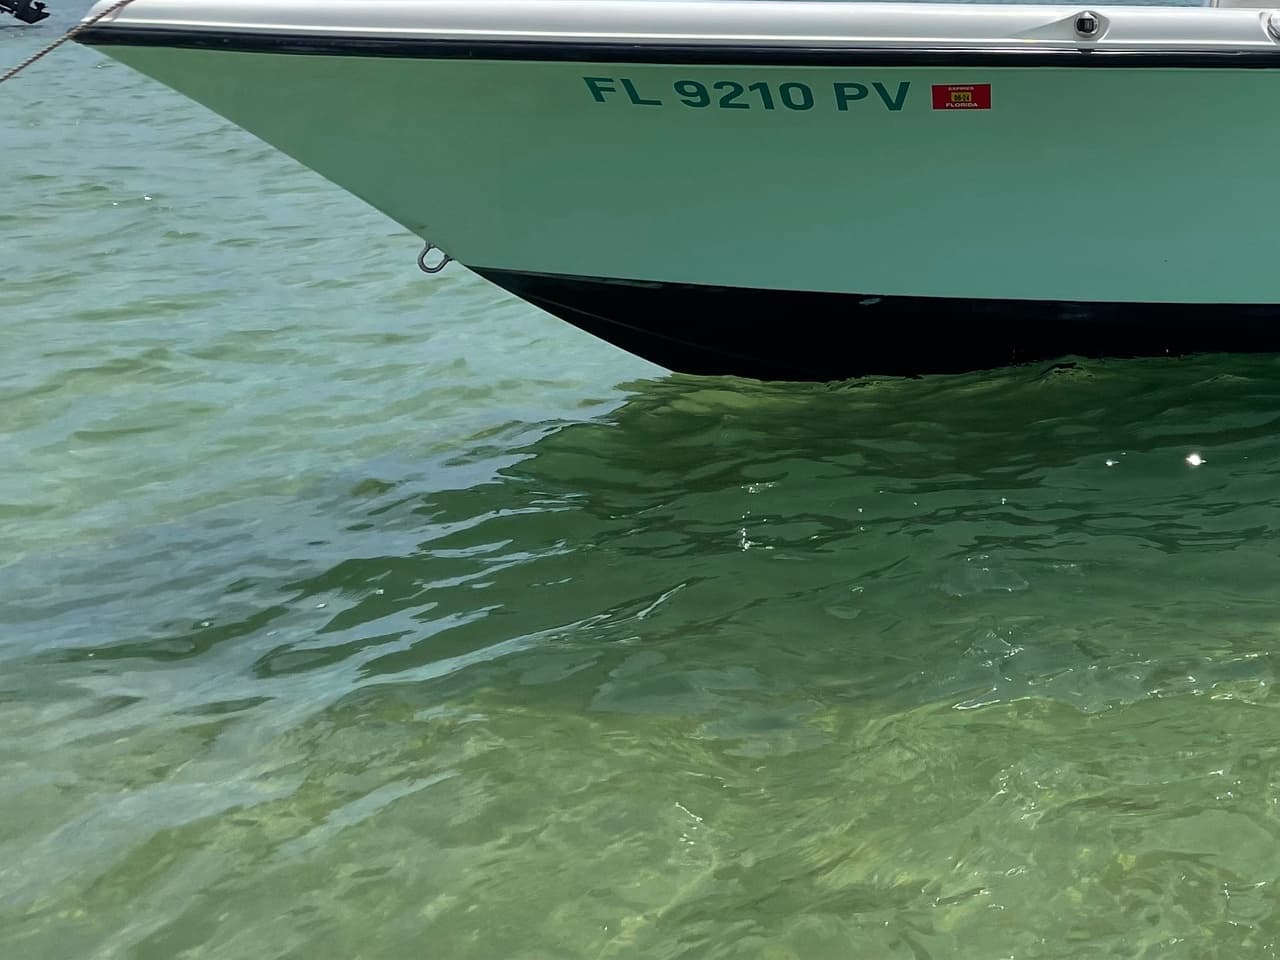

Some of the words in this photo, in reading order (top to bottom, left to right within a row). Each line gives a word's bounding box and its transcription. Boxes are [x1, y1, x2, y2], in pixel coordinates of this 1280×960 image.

[583, 76, 663, 106] FL
[673, 79, 815, 111] 9210
[833, 82, 911, 111] PV
